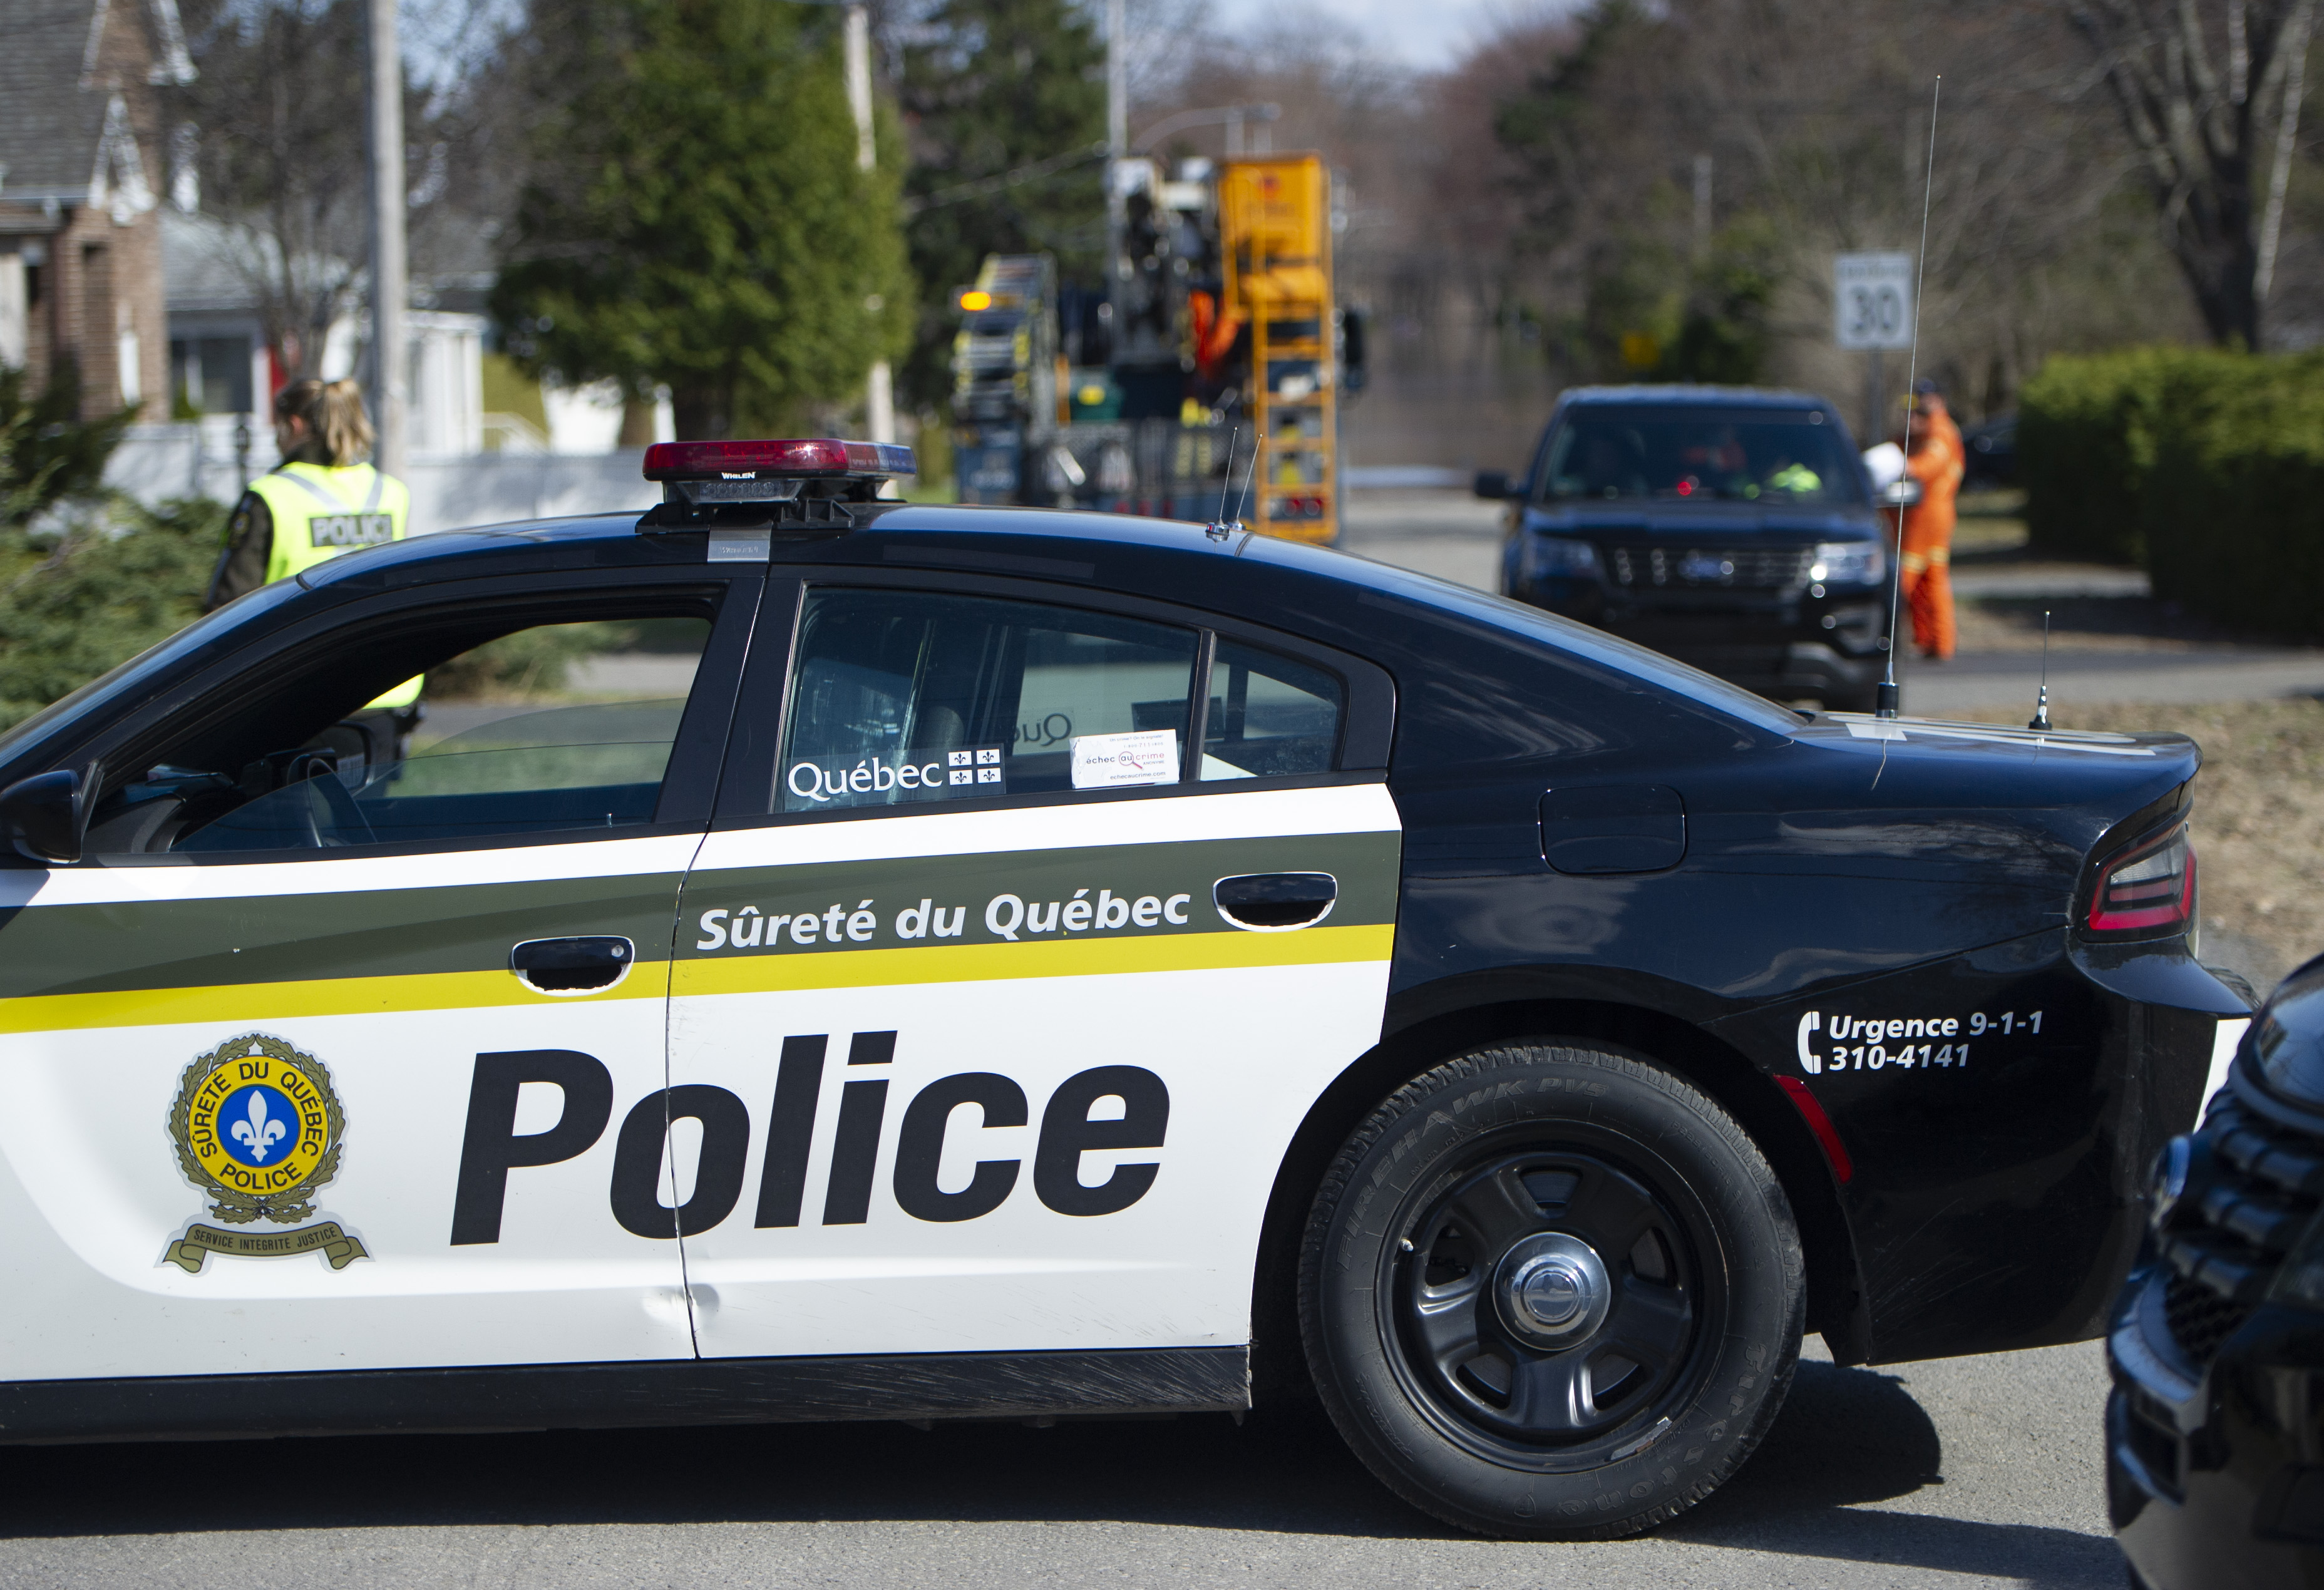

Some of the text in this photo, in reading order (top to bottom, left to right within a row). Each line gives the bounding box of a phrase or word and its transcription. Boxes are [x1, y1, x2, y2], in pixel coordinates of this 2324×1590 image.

[1849, 284, 1901, 339] 30
[788, 757, 943, 803] Québec
[1110, 771, 1166, 781] echecaucrime.com
[696, 889, 1191, 950] Sûreté du Québec
[1829, 1010, 2043, 1045] Urgence 9-1-1
[1829, 1044, 1970, 1071] 310-4141
[192, 1061, 323, 1158] SÛRETÉ DU QUÉBEC
[450, 1030, 1171, 1246] Police
[219, 1161, 302, 1190] POLICE
[1337, 1077, 1609, 1271] FIREHAWK PVS
[193, 1228, 234, 1248] SERVICE
[297, 1226, 337, 1248] JUSTICE
[1558, 1343, 1767, 1516] Firestone
